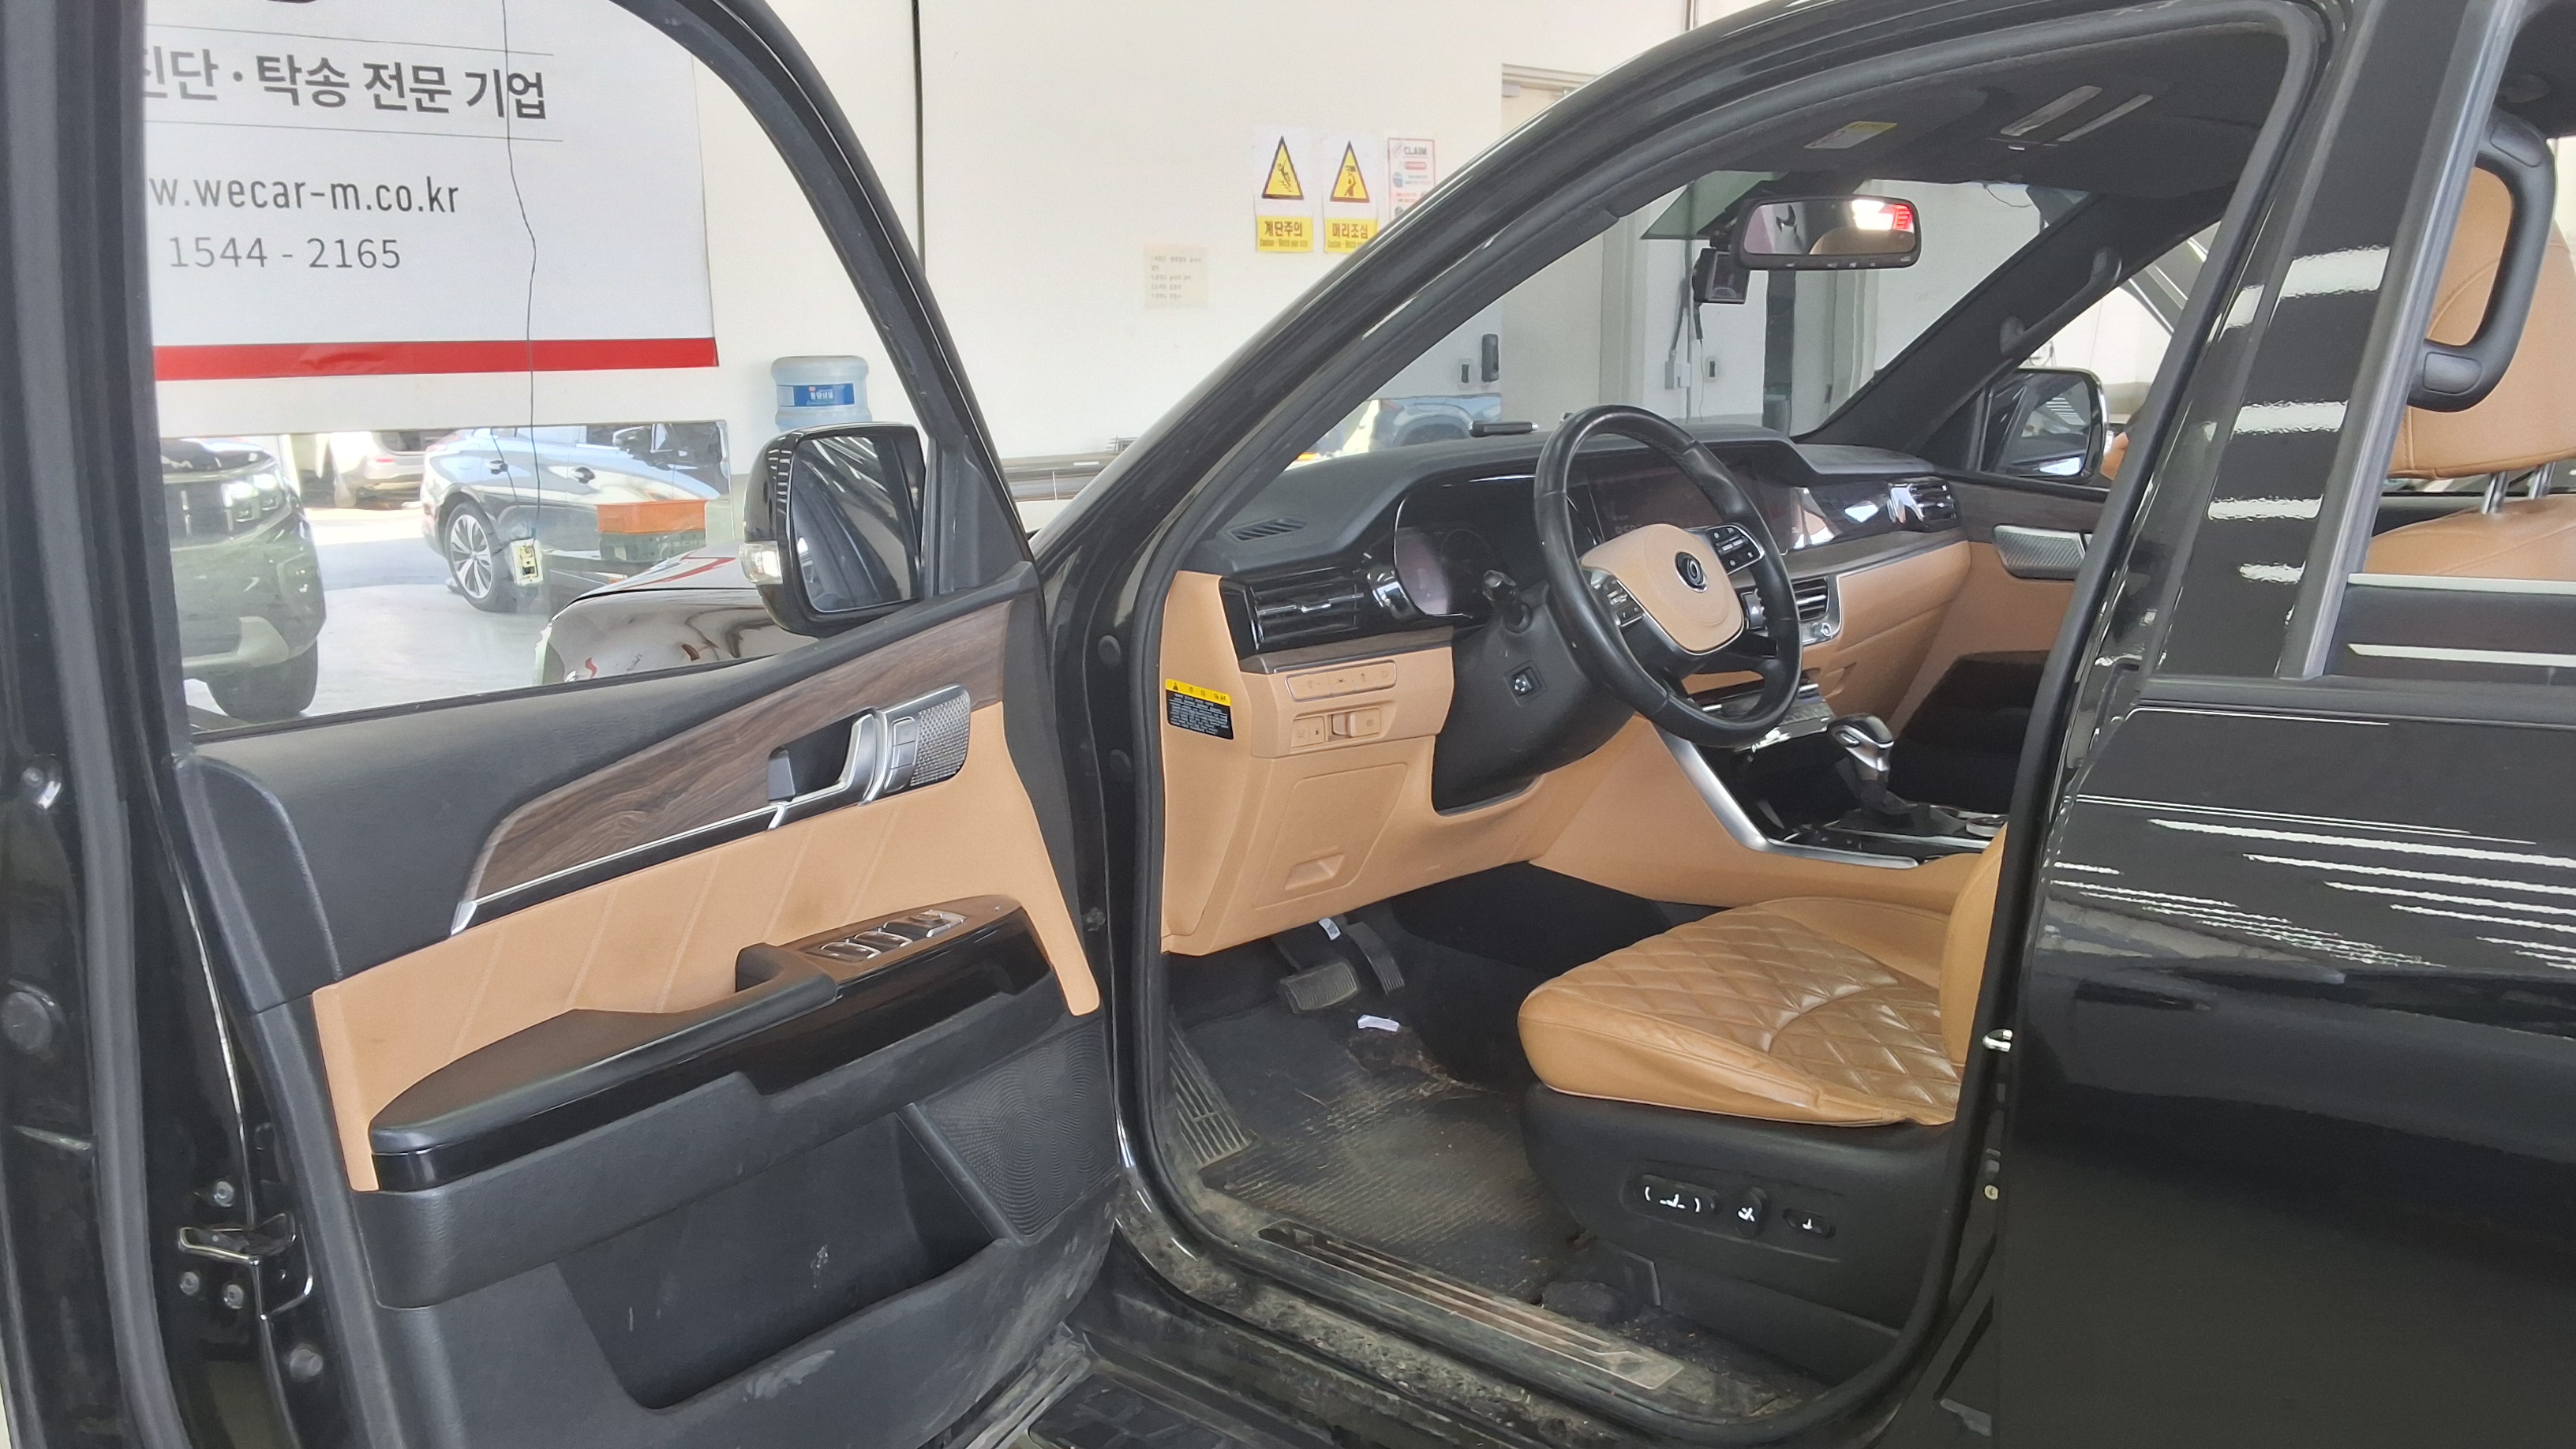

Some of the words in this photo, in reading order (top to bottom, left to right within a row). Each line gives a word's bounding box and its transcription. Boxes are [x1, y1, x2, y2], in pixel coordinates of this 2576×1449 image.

[362, 61, 452, 114] 전문
[464, 68, 547, 120] 기업
[1404, 146, 1428, 155] CLAIM
[1264, 220, 1303, 238] 계단주의
[1331, 222, 1368, 239] 머리조심
